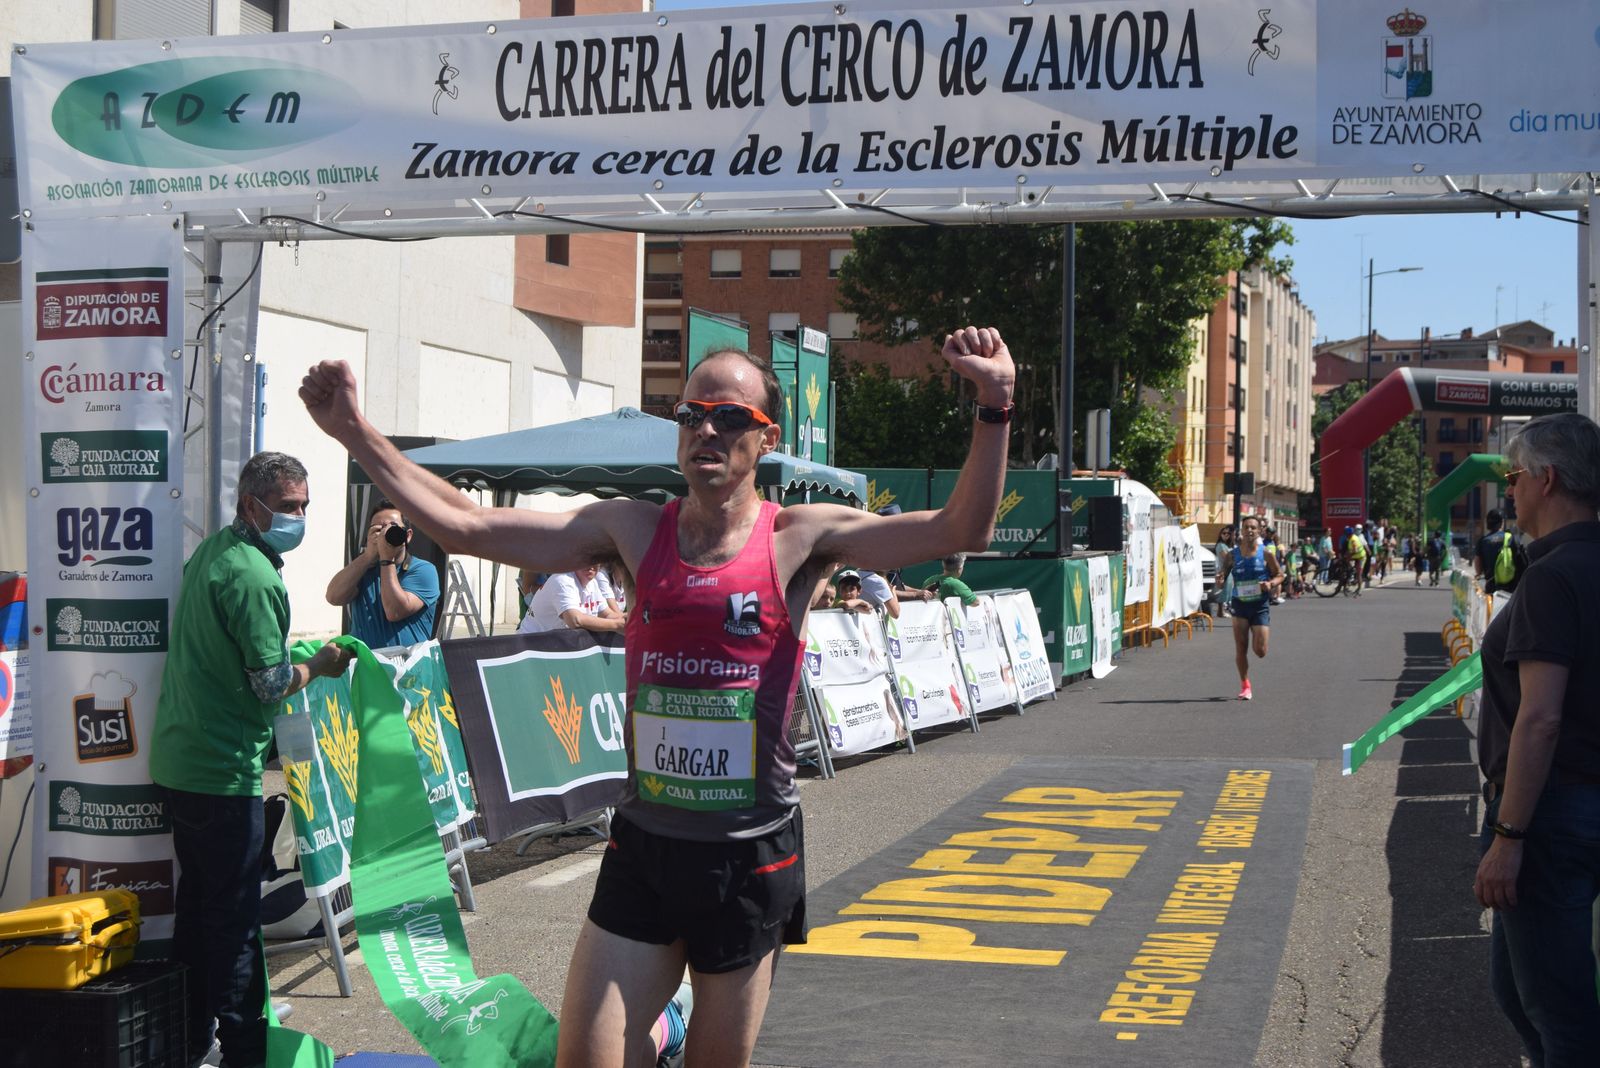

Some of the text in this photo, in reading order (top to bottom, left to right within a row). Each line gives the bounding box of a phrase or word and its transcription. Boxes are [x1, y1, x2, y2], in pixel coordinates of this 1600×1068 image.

[495, 8, 1204, 121] CARRERA del CERCO de ZAMORA
[1333, 103, 1482, 123] AYUNTAMIENTO
[1509, 109, 1600, 132] dia mu
[1332, 122, 1481, 144] DE ZAMORA
[405, 114, 1298, 179] Zamora cerca de la Esclerosis Múltiple
[47, 163, 379, 201] ASOCIACIÓN ZAMORANA DE ESCLEROSIS MÚLTIPLE
[65, 291, 160, 306] DIPUTACIÓN DE
[64, 306, 161, 328] ZAMORA
[1501, 380, 1530, 392] CON
[1531, 382, 1547, 393] EL
[85, 401, 121, 413] Zamora
[1501, 396, 1562, 408] GANAMOS
[81, 449, 160, 463] FUNDACION
[82, 463, 160, 477] CAJA RURAL
[56, 507, 153, 567] gaza
[58, 570, 153, 582] Ganaderos de Zamora
[83, 620, 160, 633] FUNDACION
[83, 633, 160, 647] CAJA RURAL
[640, 651, 760, 681] Fisiorama
[666, 692, 739, 707] FUNDACION
[666, 705, 739, 718] CAJA RURAL
[78, 711, 128, 746] Susi
[655, 743, 729, 777] GARGAR
[666, 785, 748, 801] CAJA RURAL
[82, 802, 163, 817] FUNDACION
[82, 816, 163, 830] CAJA RURAL
[784, 786, 1183, 966] PIDEPAR
[1155, 862, 1246, 925] INTEGRAL
[1099, 931, 1221, 1025] REFORMA
